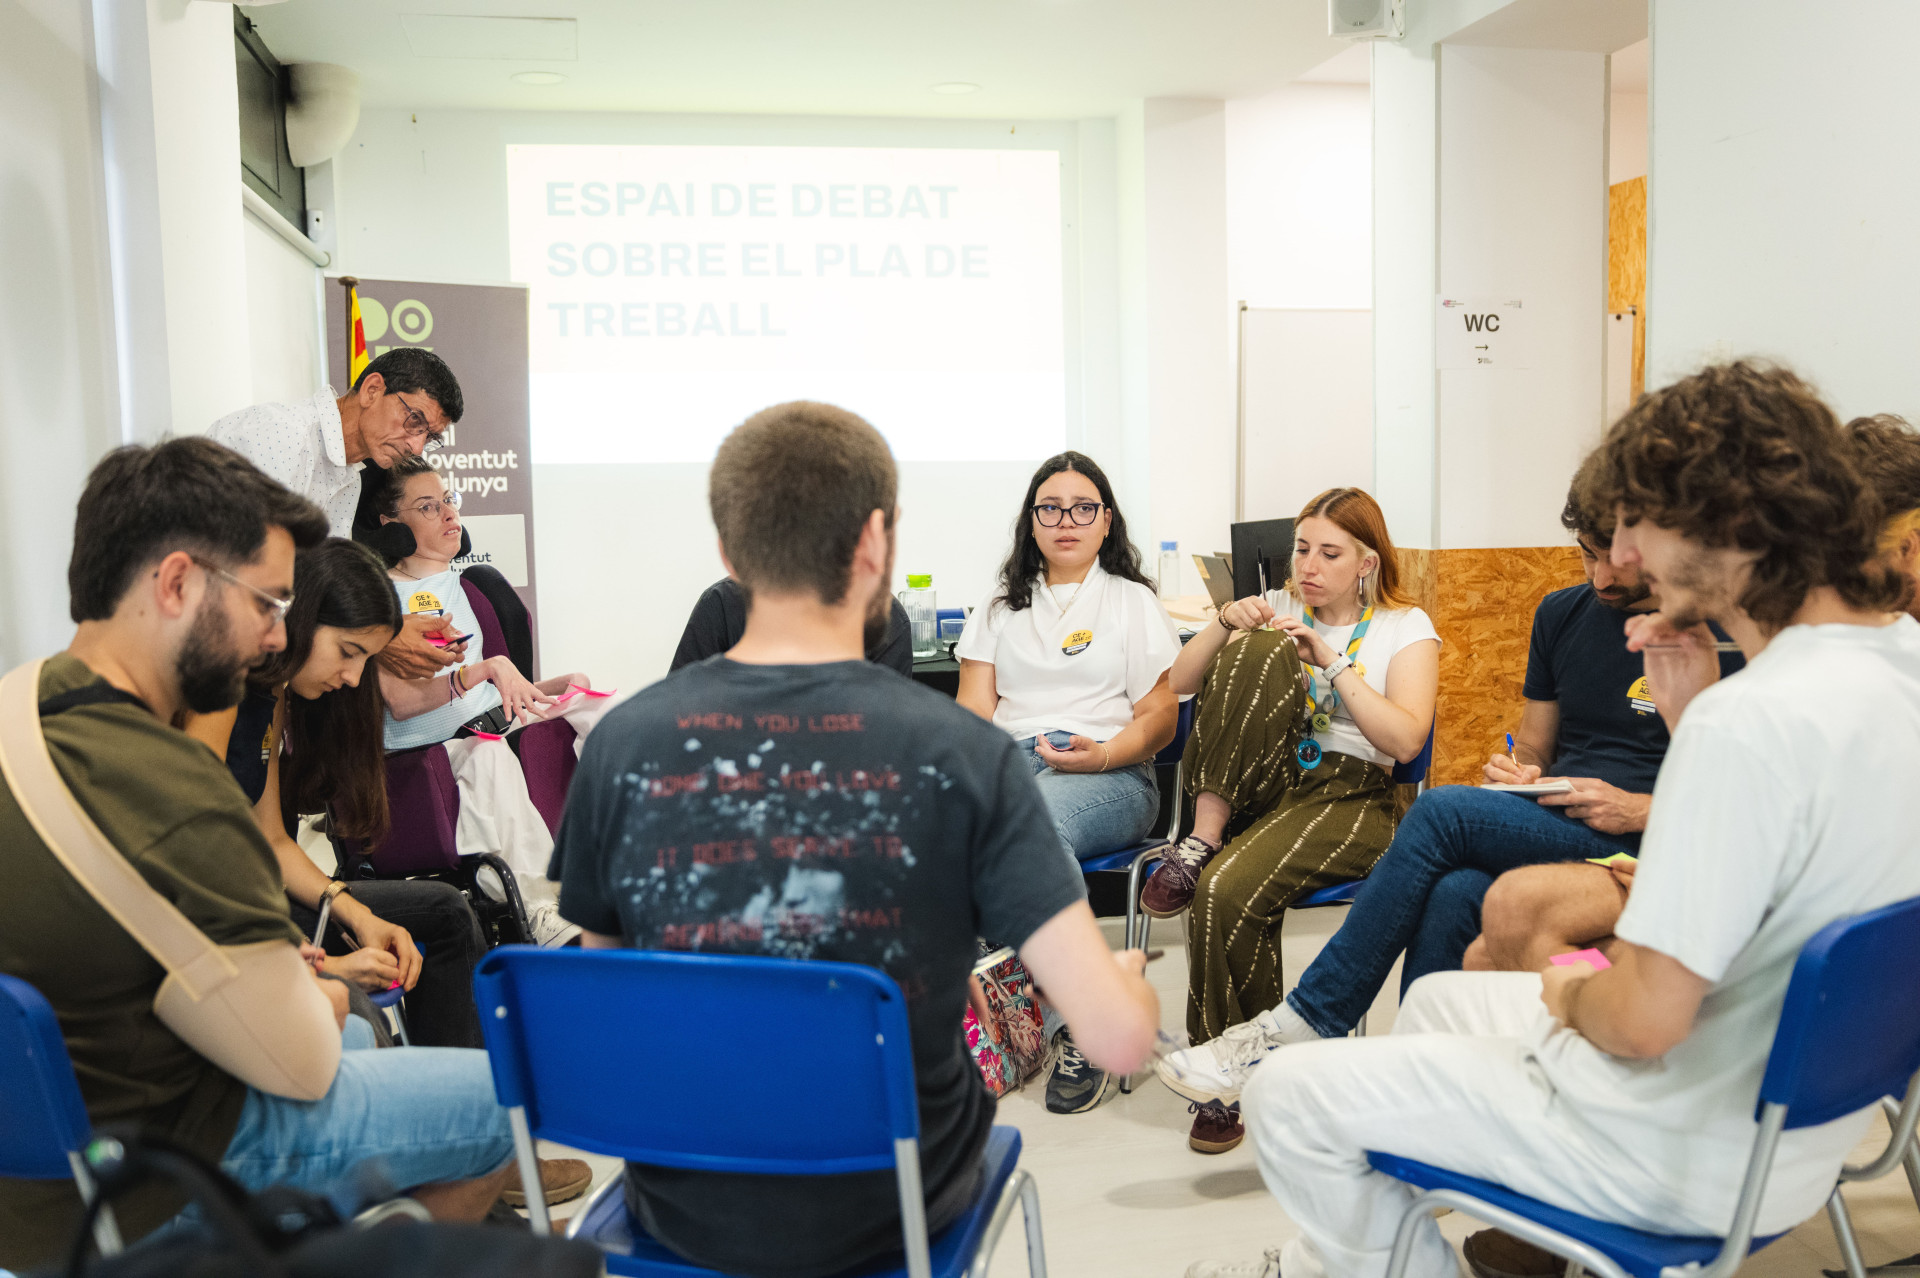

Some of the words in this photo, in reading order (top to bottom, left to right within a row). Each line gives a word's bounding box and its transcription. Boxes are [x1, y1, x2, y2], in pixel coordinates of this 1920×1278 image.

[545, 181, 696, 218] ESPAI
[710, 182, 777, 218] DE
[791, 183, 958, 219] DEBAT
[546, 241, 728, 277] SOBRE
[741, 242, 802, 277] EL
[815, 243, 912, 278] PLA
[925, 244, 990, 279] DE
[547, 301, 787, 338] TREBALL
[1463, 313, 1500, 332] WC
[677, 712, 744, 732] WHEN
[755, 713, 800, 734] YOU
[808, 712, 866, 733] LOSE
